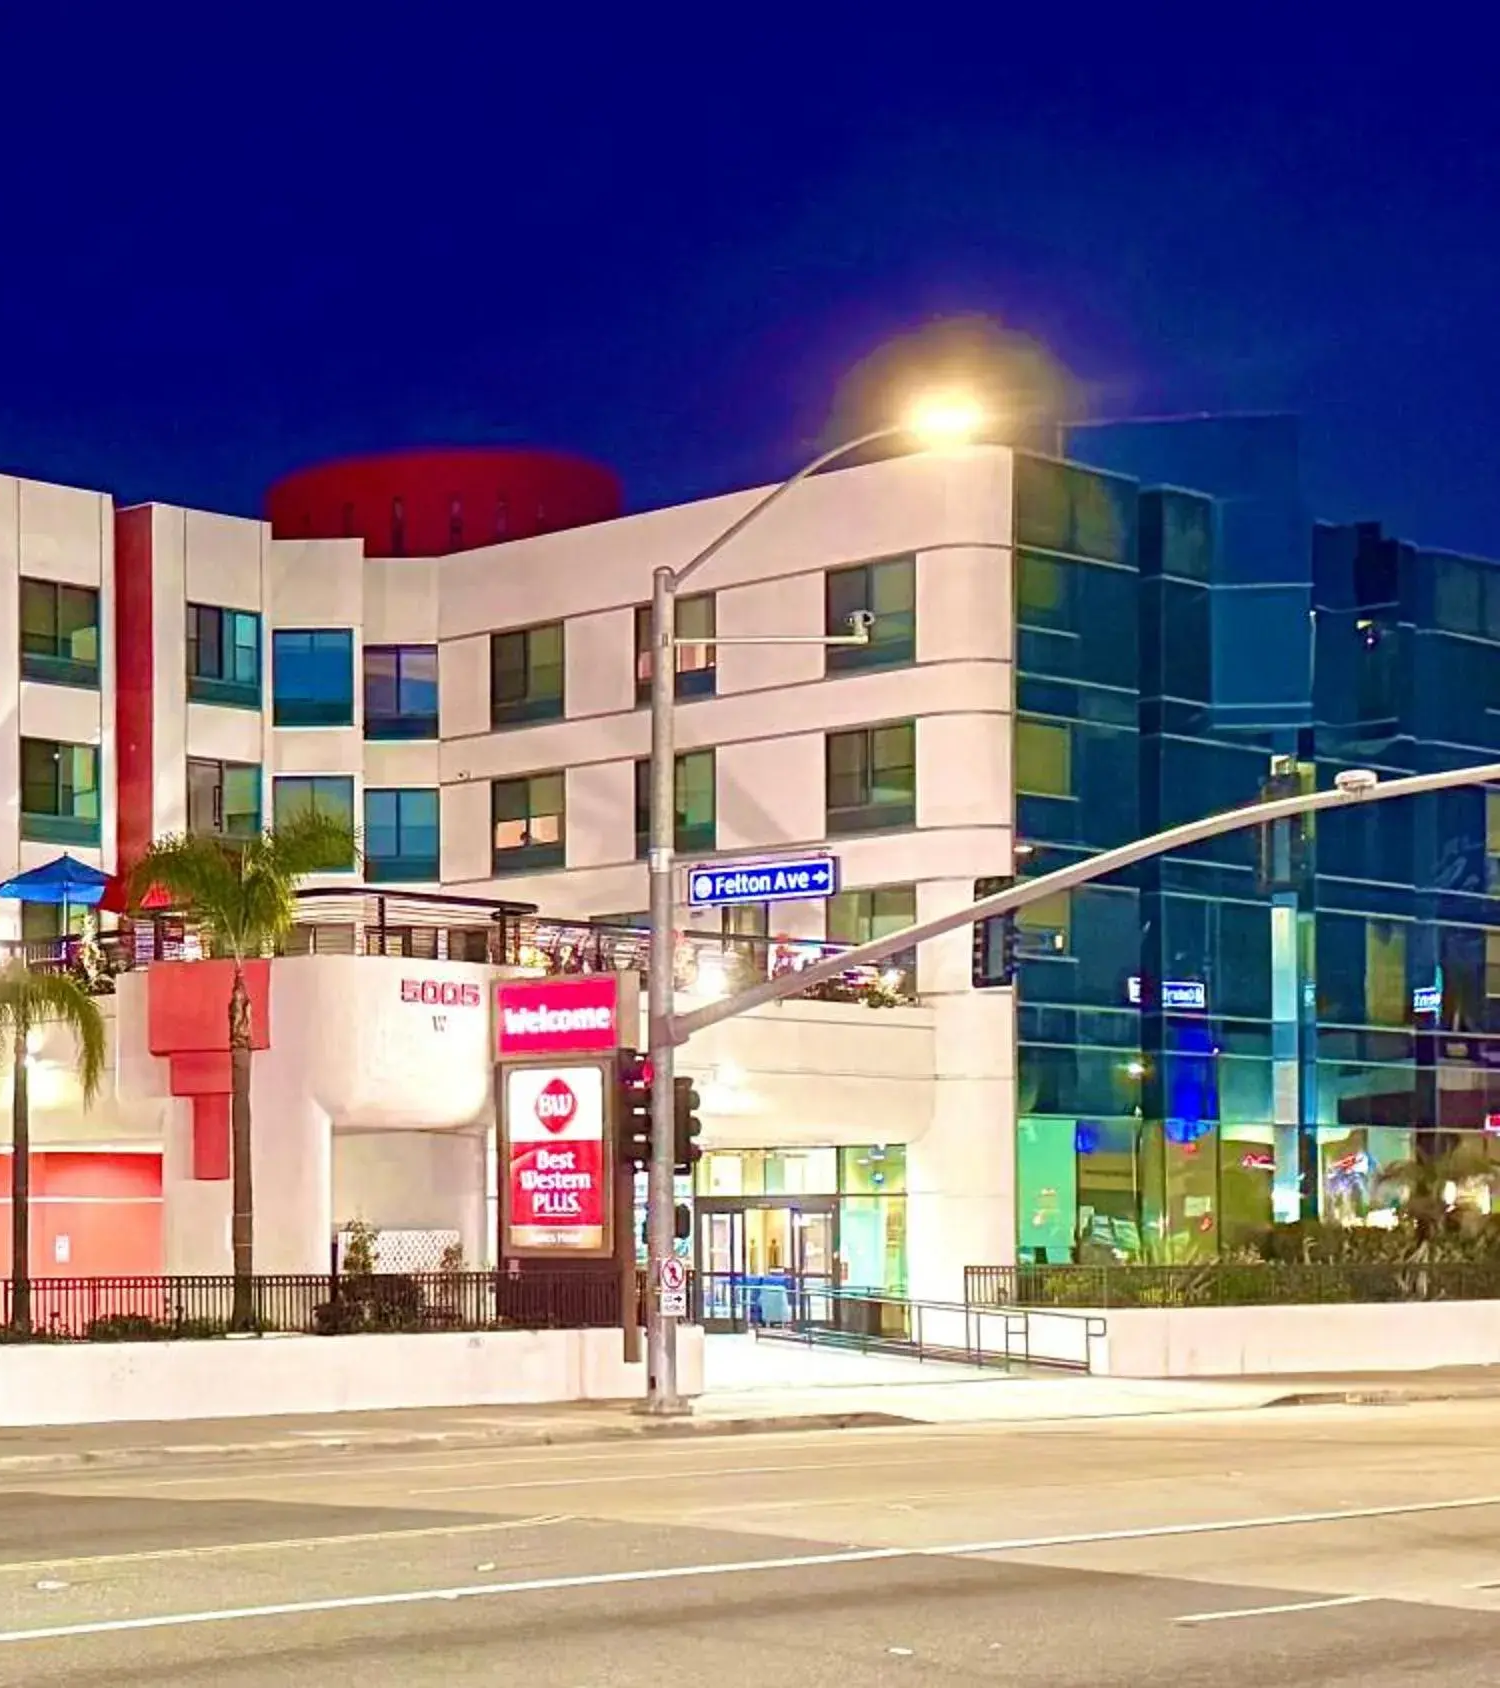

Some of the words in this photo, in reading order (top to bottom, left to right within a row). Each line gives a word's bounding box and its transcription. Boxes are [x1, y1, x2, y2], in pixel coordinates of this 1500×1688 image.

[715, 873, 771, 895] Felton
[774, 871, 810, 891] Ave
[401, 979, 480, 1006] 5005
[504, 1004, 611, 1035] Welcome
[539, 1094, 573, 1117] BW
[536, 1149, 576, 1170] Best
[520, 1170, 591, 1190] Western
